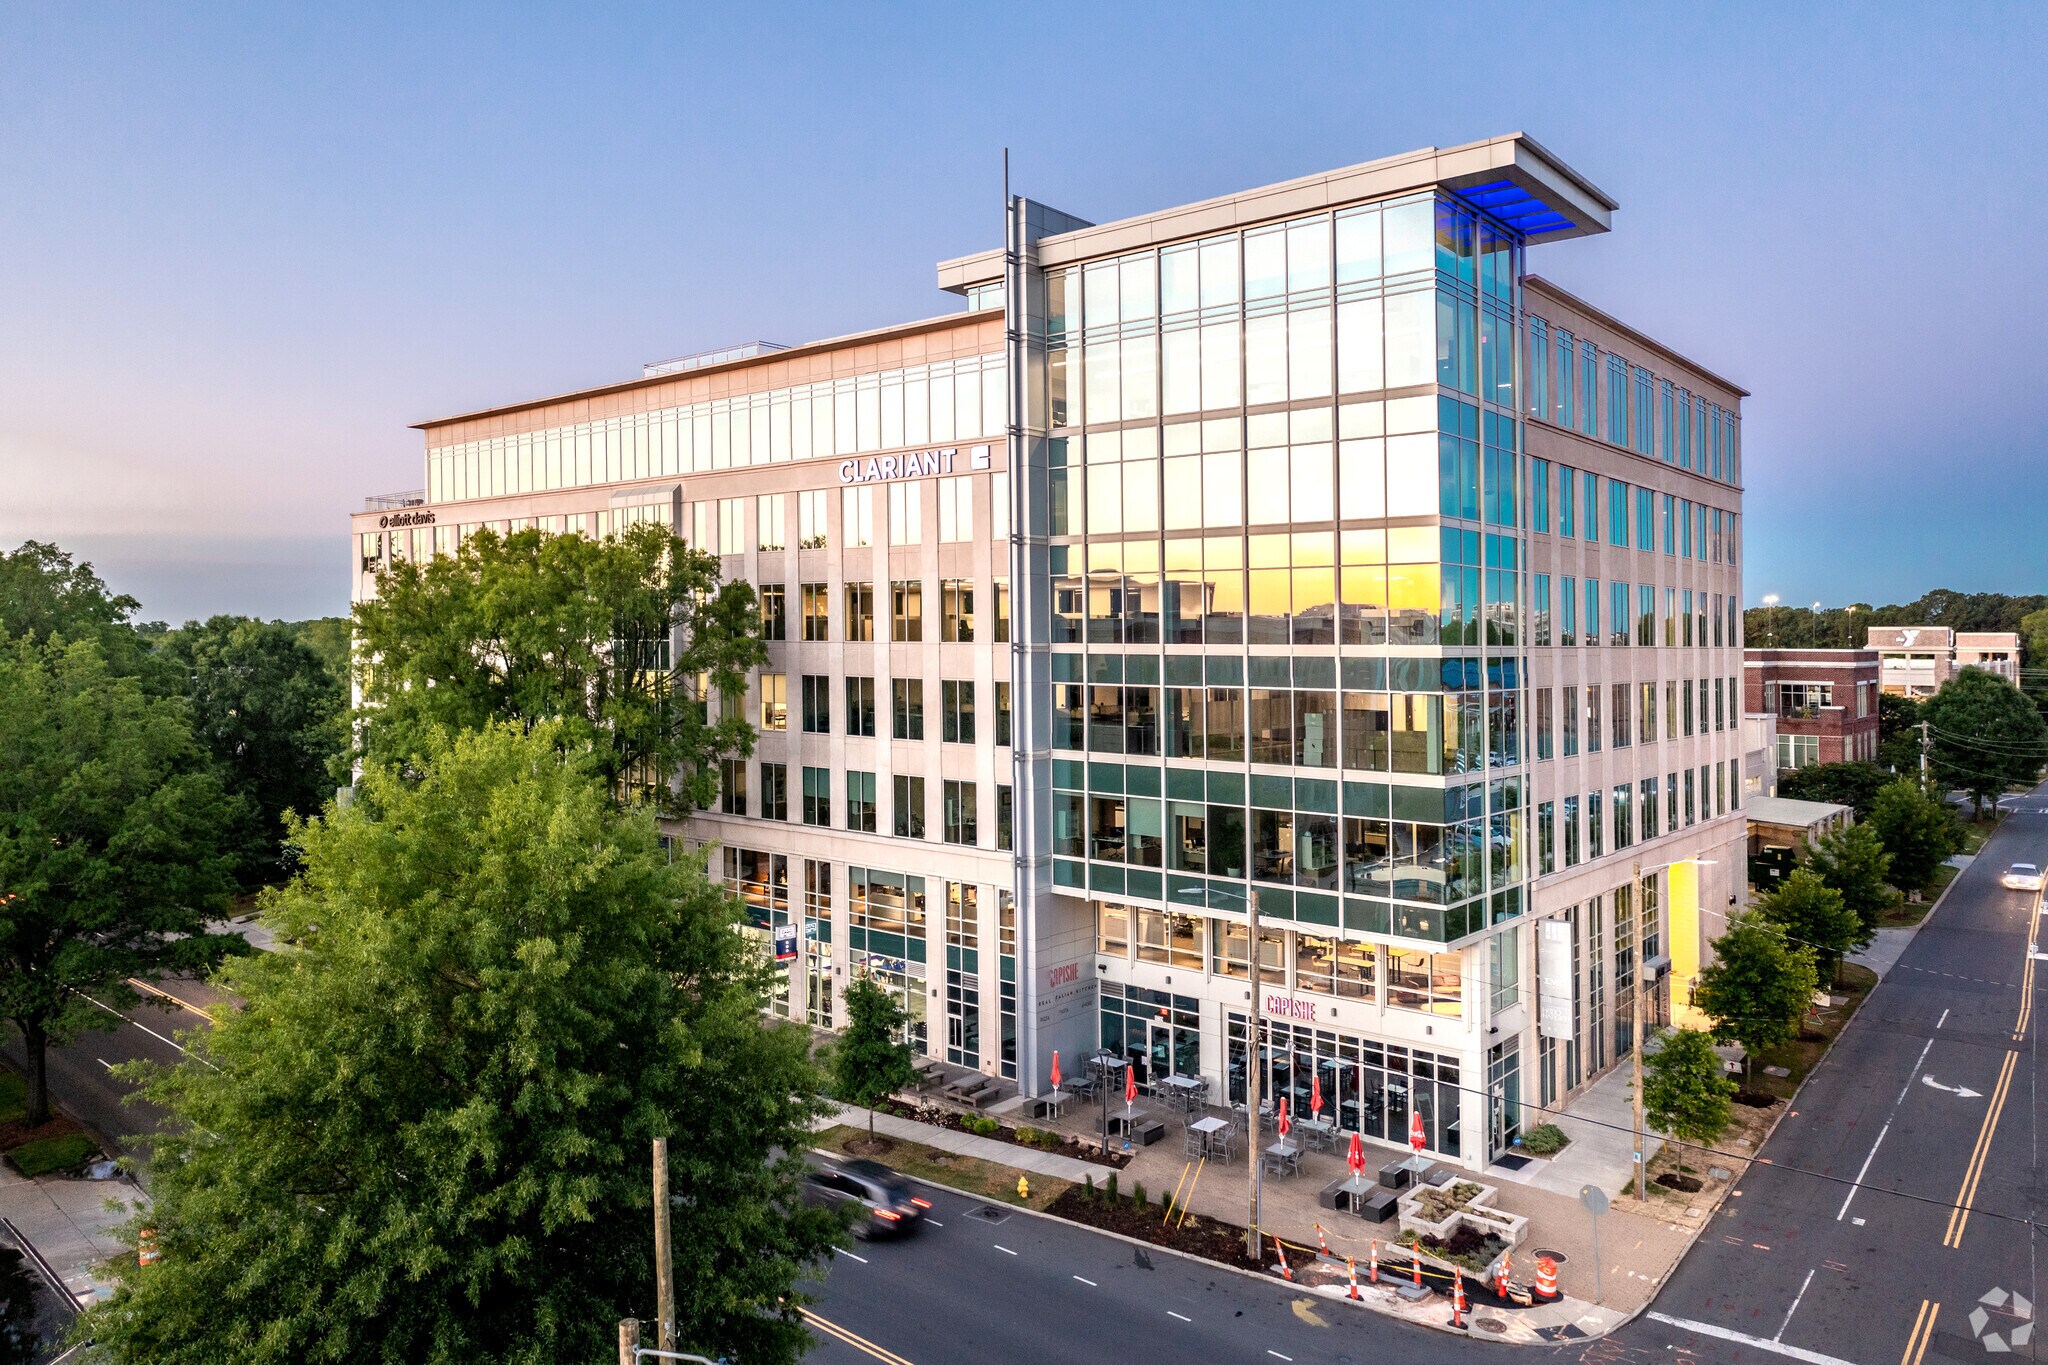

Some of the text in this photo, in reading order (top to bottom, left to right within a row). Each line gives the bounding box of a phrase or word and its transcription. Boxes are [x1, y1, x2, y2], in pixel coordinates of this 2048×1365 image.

[838, 448, 958, 484] CLARIANT
[412, 510, 436, 525] davis
[1049, 963, 1079, 988] CAPISHE
[1265, 994, 1316, 1022] CAPISHE
